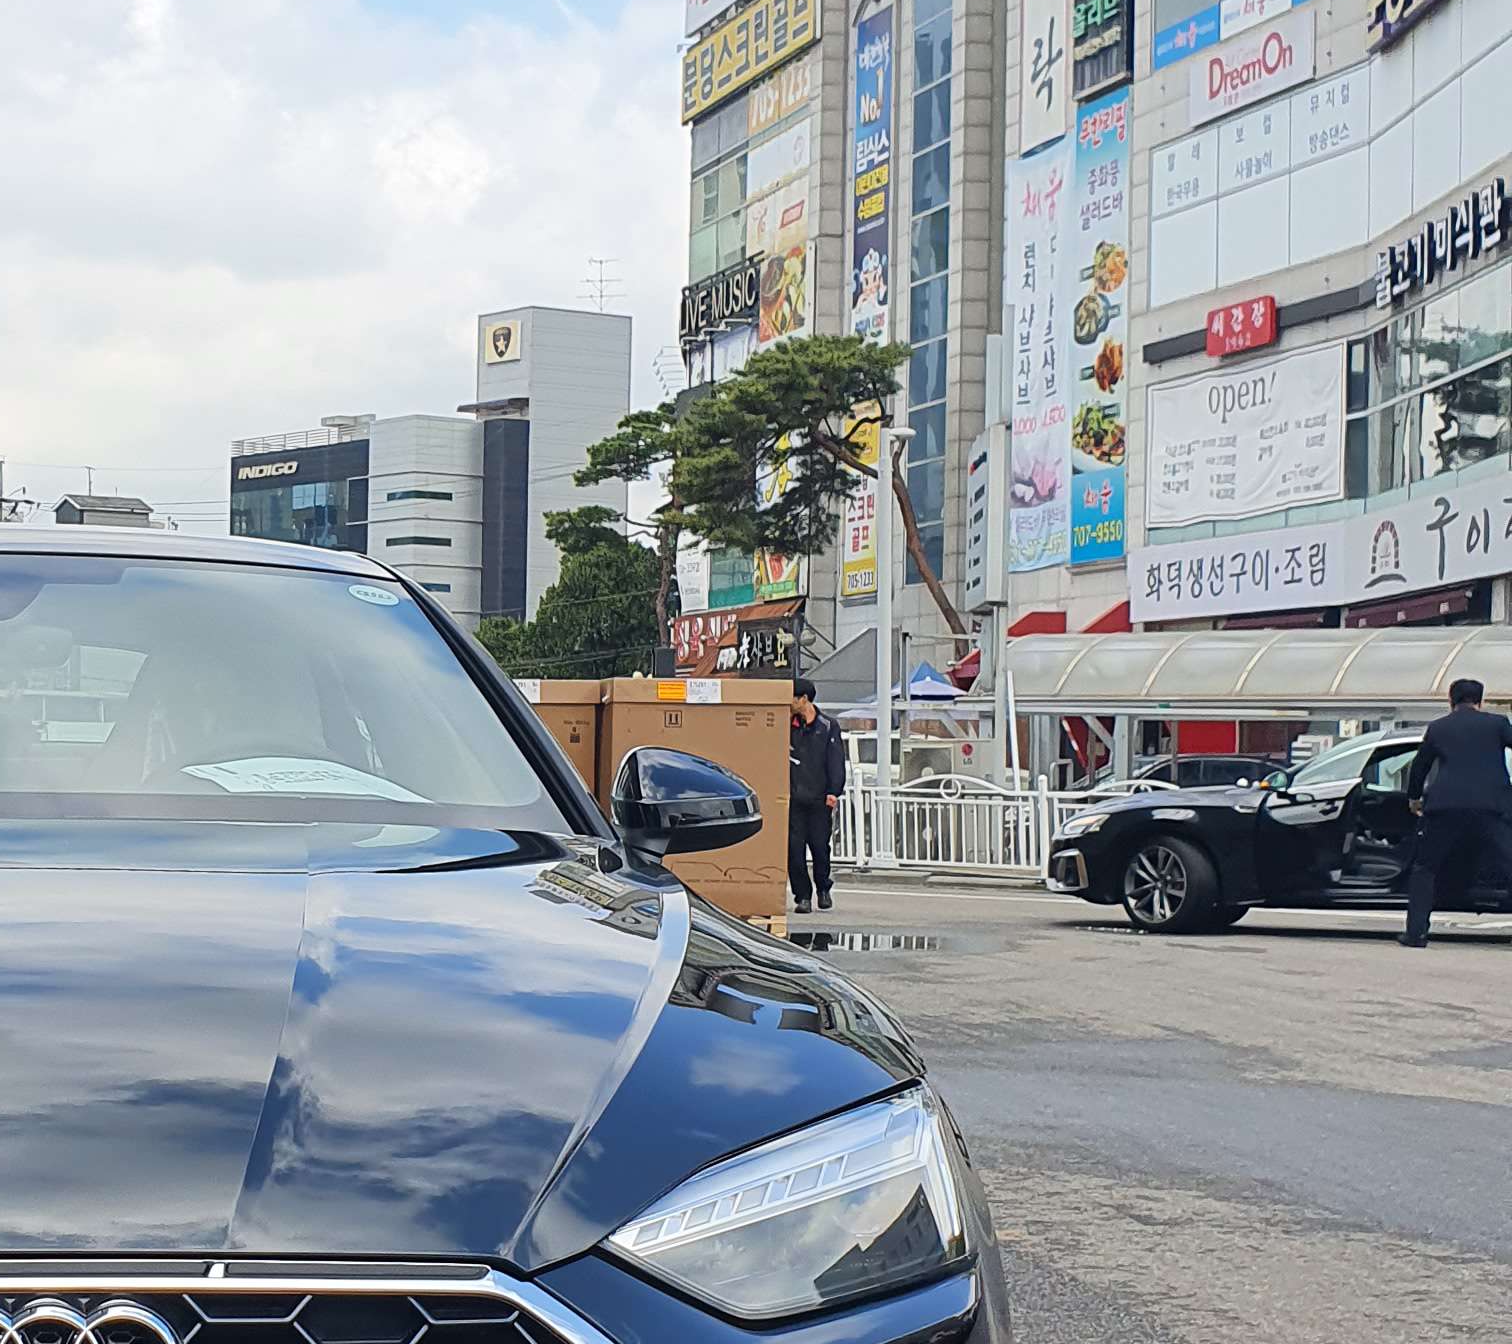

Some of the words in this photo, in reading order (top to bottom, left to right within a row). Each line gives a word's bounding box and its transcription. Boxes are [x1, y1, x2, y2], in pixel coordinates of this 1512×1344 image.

[711, 267, 756, 321] MUSIC
[1208, 371, 1277, 424] open!
[238, 461, 298, 480] INDIGO
[1072, 519, 1123, 548] 707-9550
[1426, 496, 1512, 581] 구이
